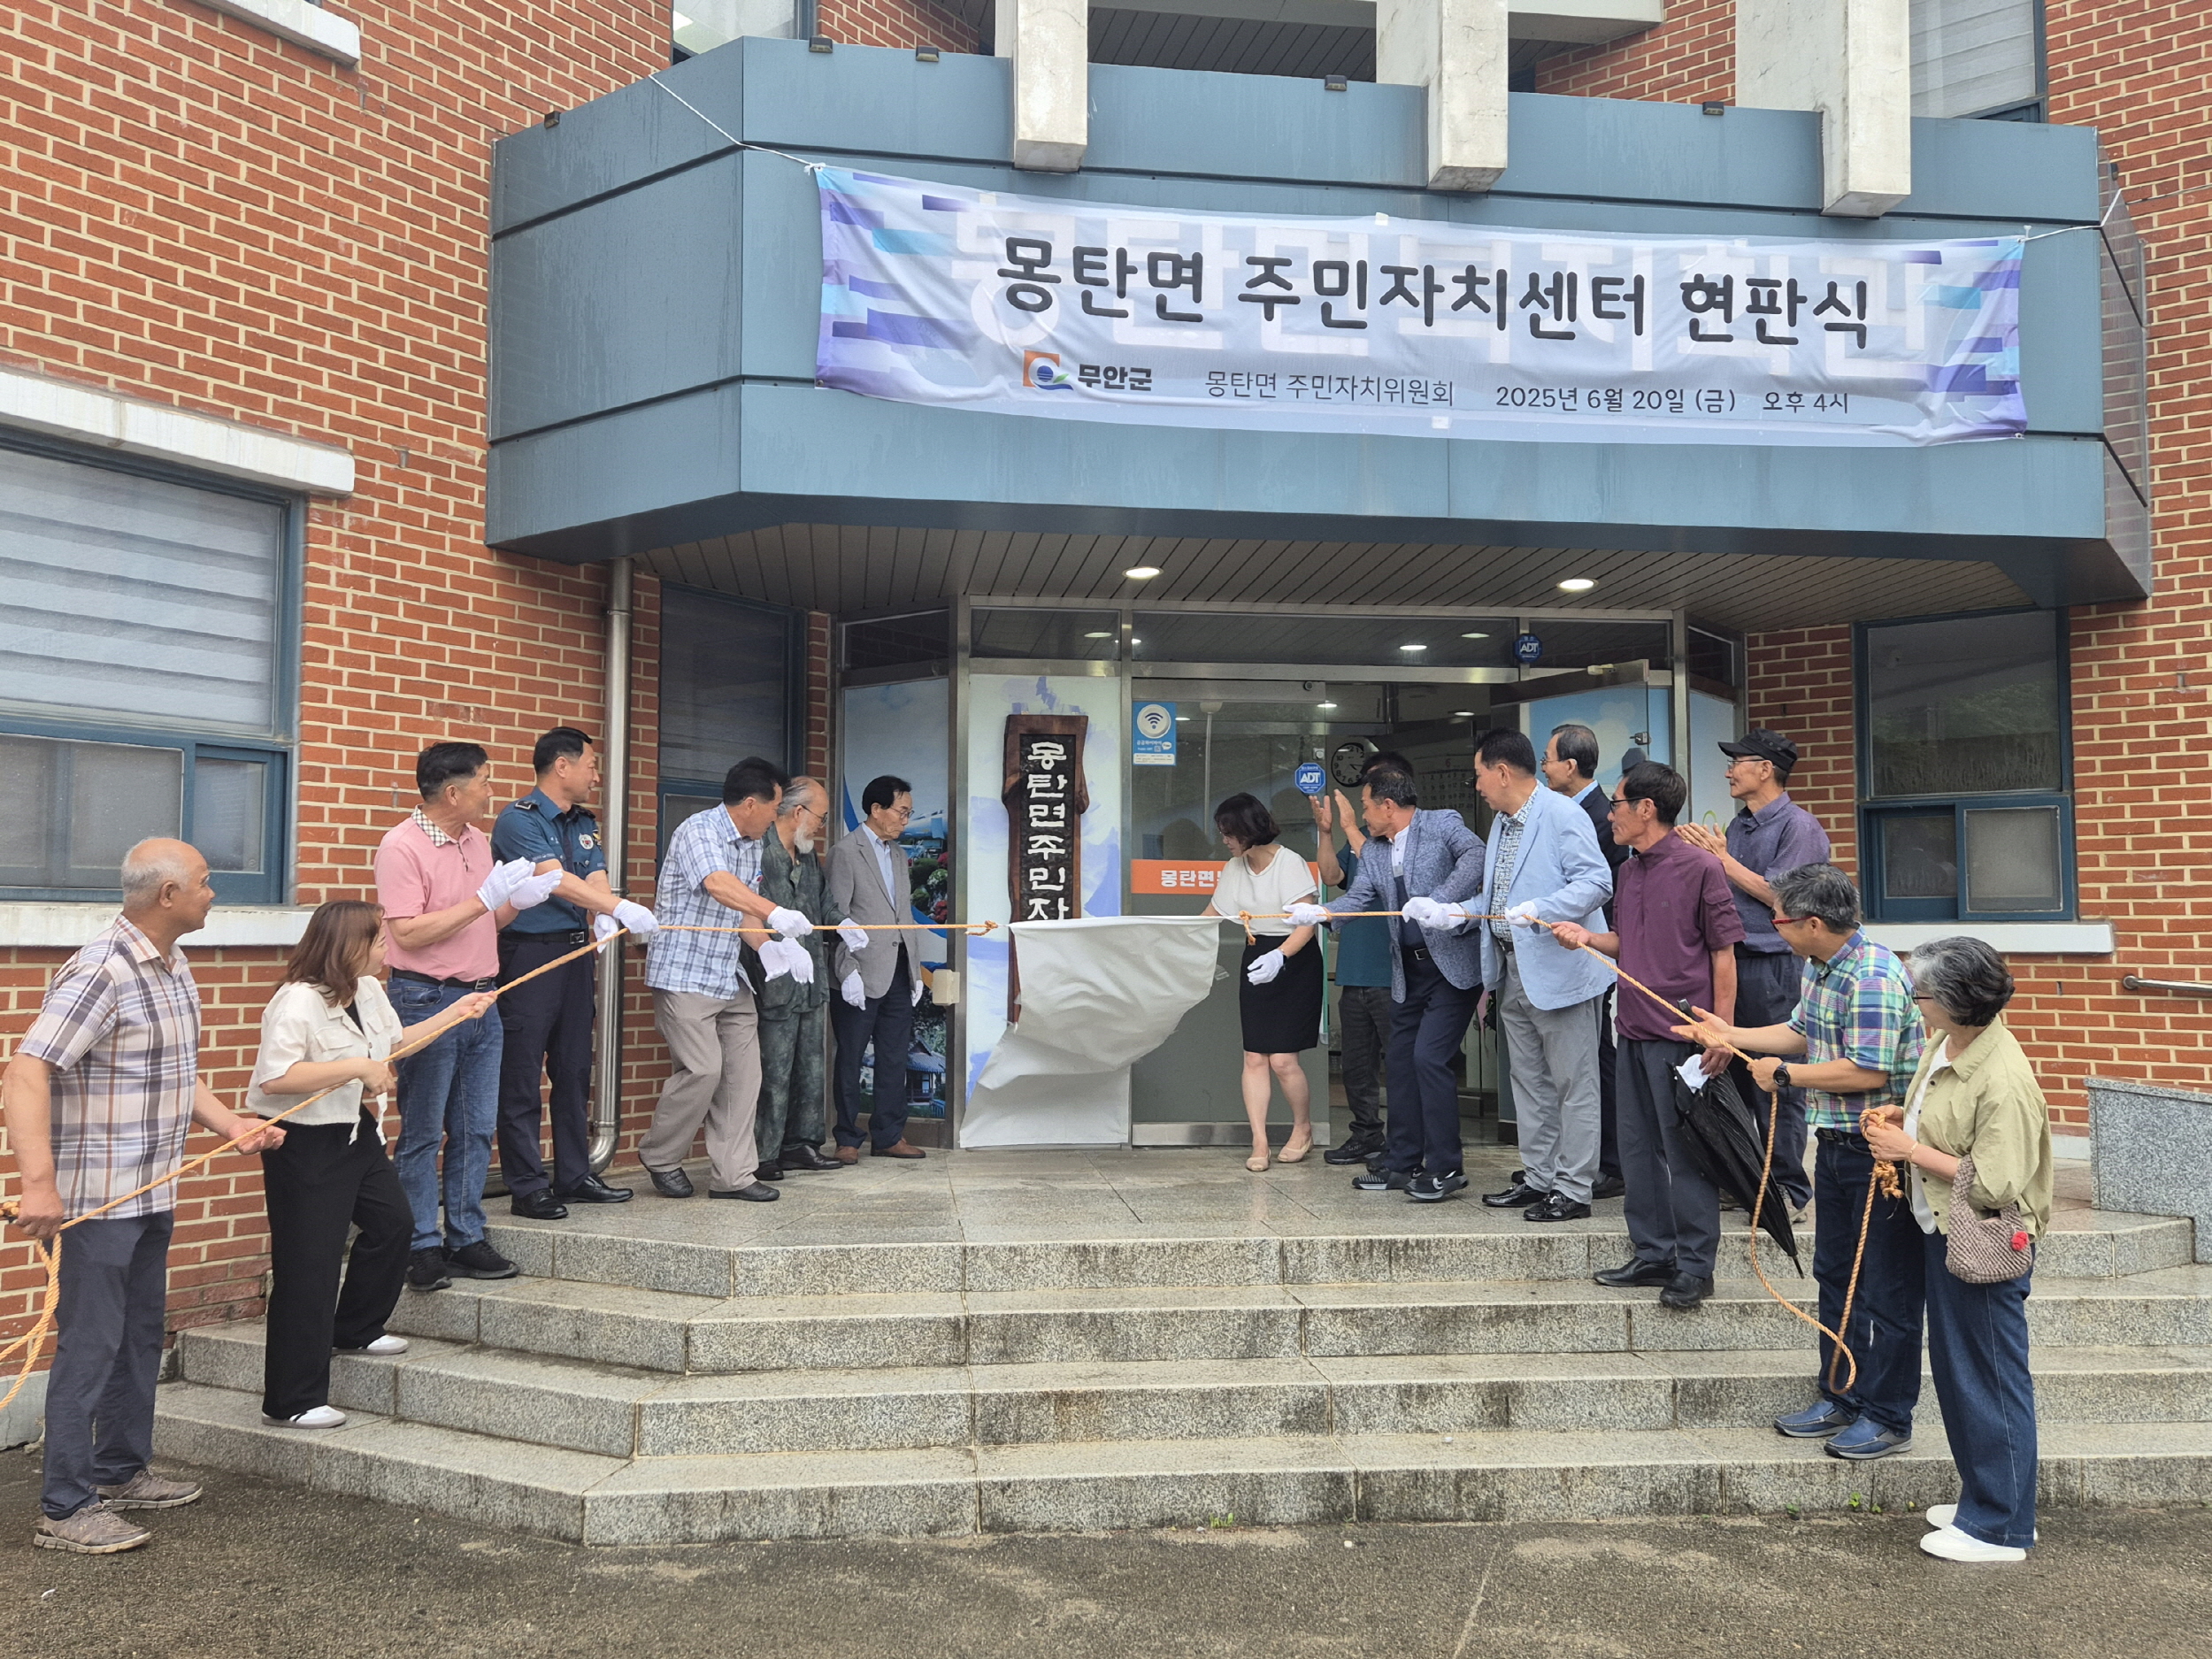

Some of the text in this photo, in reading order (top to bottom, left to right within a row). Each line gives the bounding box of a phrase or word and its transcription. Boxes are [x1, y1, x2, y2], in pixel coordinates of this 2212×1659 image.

[997, 236, 1868, 349] 몽탄면 주민자치센터 현판식
[1077, 365, 1153, 392] 무안군
[1204, 370, 1454, 408] 몽탄면 주민자치위원회
[1495, 386, 1849, 415] 2025년 6월 20일 (금) 오후 4시
[1520, 642, 1539, 653] ADT
[1300, 772, 1321, 784] ADT
[1161, 870, 1222, 887] 몽탄면
